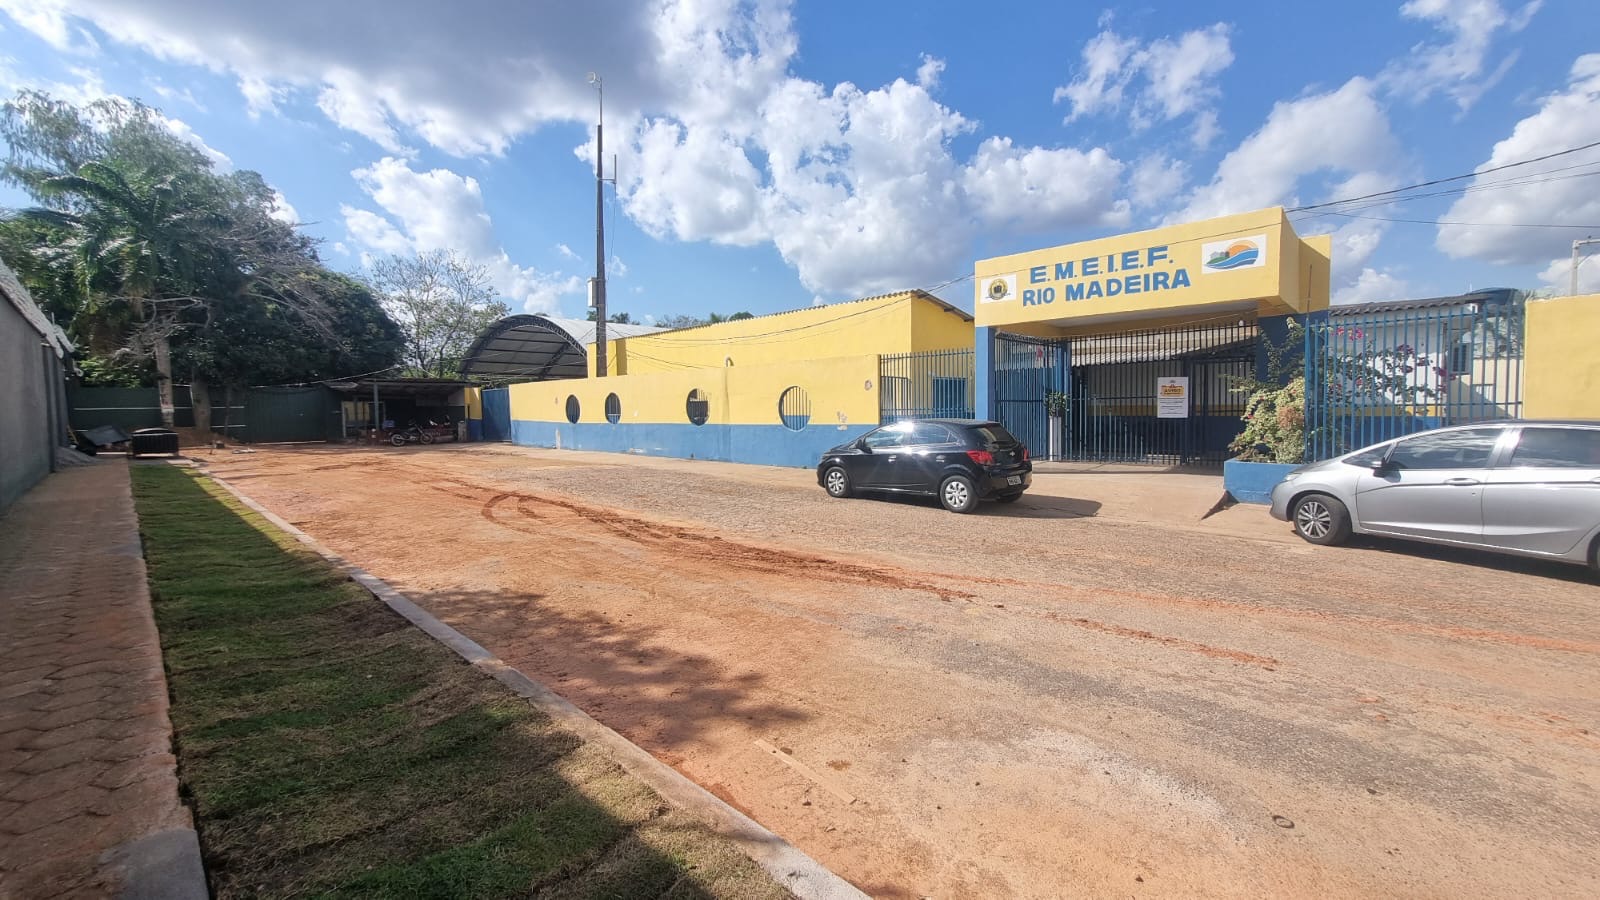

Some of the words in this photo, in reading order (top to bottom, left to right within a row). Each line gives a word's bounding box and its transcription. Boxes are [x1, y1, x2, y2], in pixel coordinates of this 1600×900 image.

[1030, 245, 1174, 284] E.M.E.I.E.F.
[1023, 287, 1055, 307] RIO
[1065, 268, 1191, 302] MADEIRA
